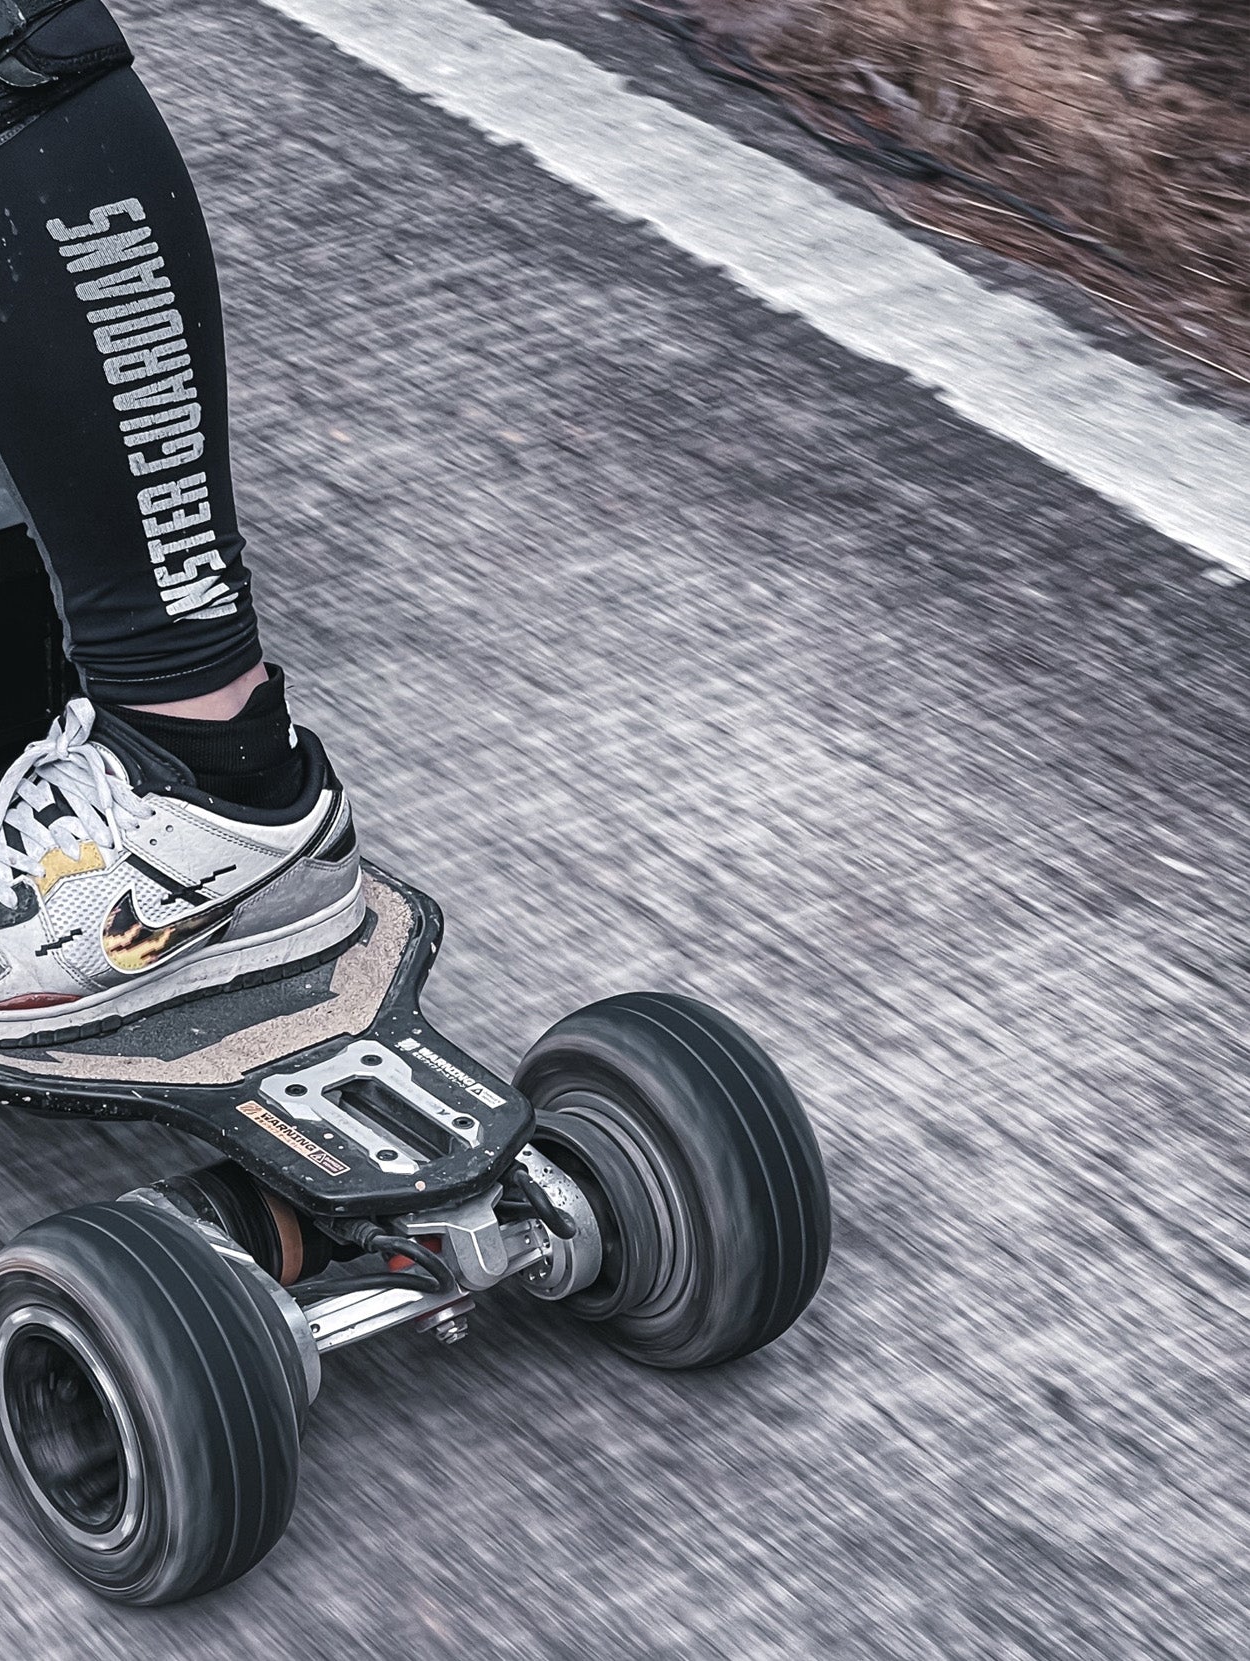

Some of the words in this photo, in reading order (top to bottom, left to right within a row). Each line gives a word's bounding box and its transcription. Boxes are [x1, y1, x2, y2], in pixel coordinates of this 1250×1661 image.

[46, 197, 205, 478] GUARDIANS
[417, 1046, 476, 1086] WARNING
[260, 1112, 317, 1151] WARNING
